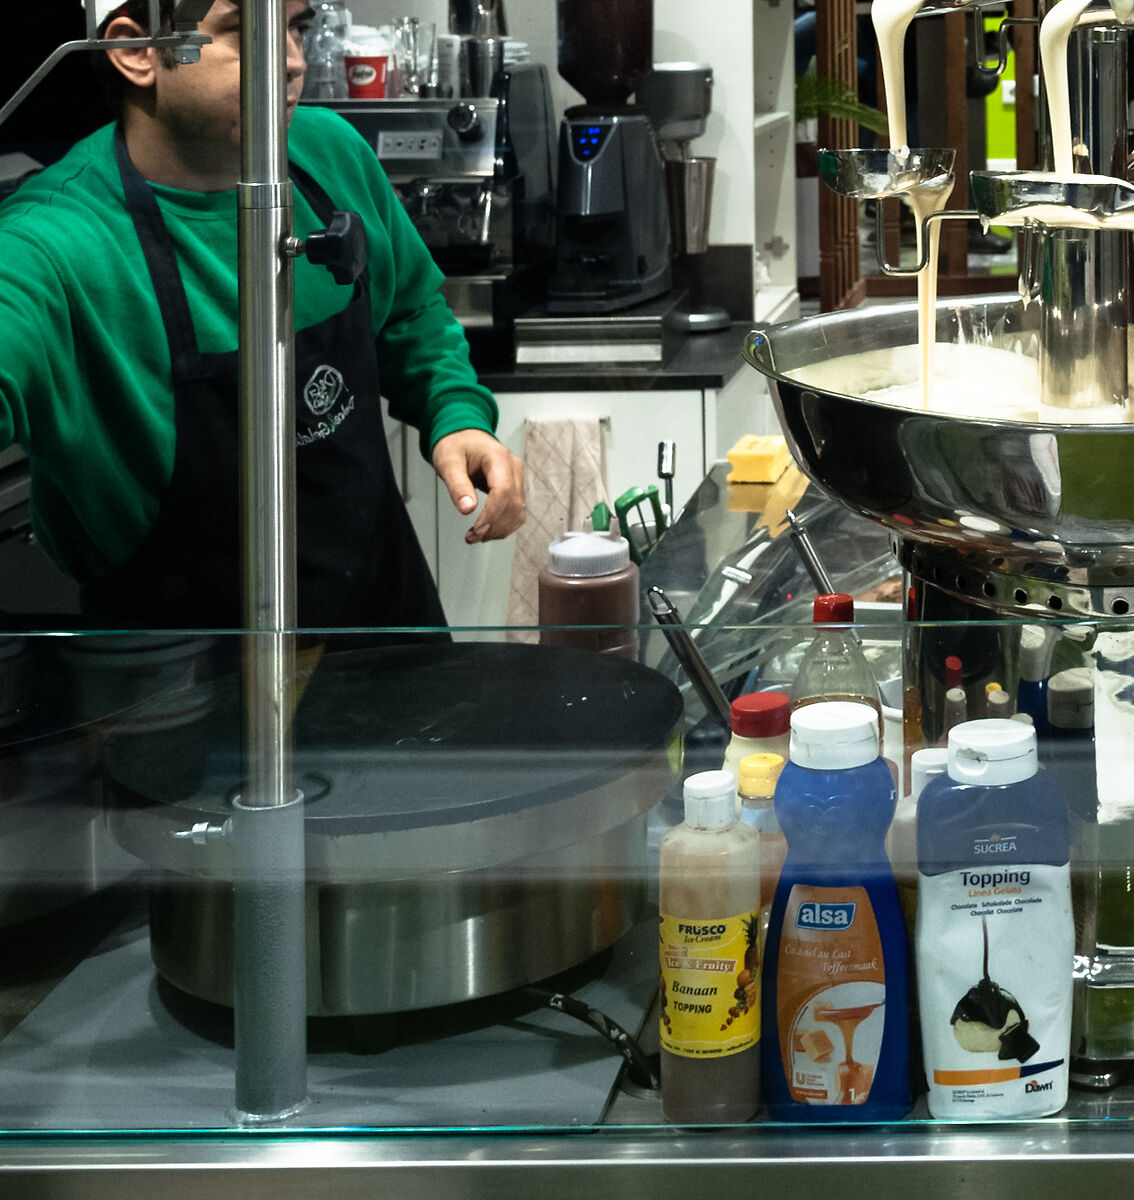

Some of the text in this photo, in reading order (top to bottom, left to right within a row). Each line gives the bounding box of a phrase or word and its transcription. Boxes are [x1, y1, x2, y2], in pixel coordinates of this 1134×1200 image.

[974, 841, 1017, 854] SUCREA
[960, 869, 1031, 888] Topping
[801, 902, 849, 925] alsa
[678, 923, 727, 936] FRUSCO
[684, 934, 722, 944] Ice Cream
[696, 959, 731, 973] Fruity
[672, 981, 718, 996] Banaan
[673, 1000, 713, 1014] TOPPING
[1025, 1082, 1053, 1094] Dawn
